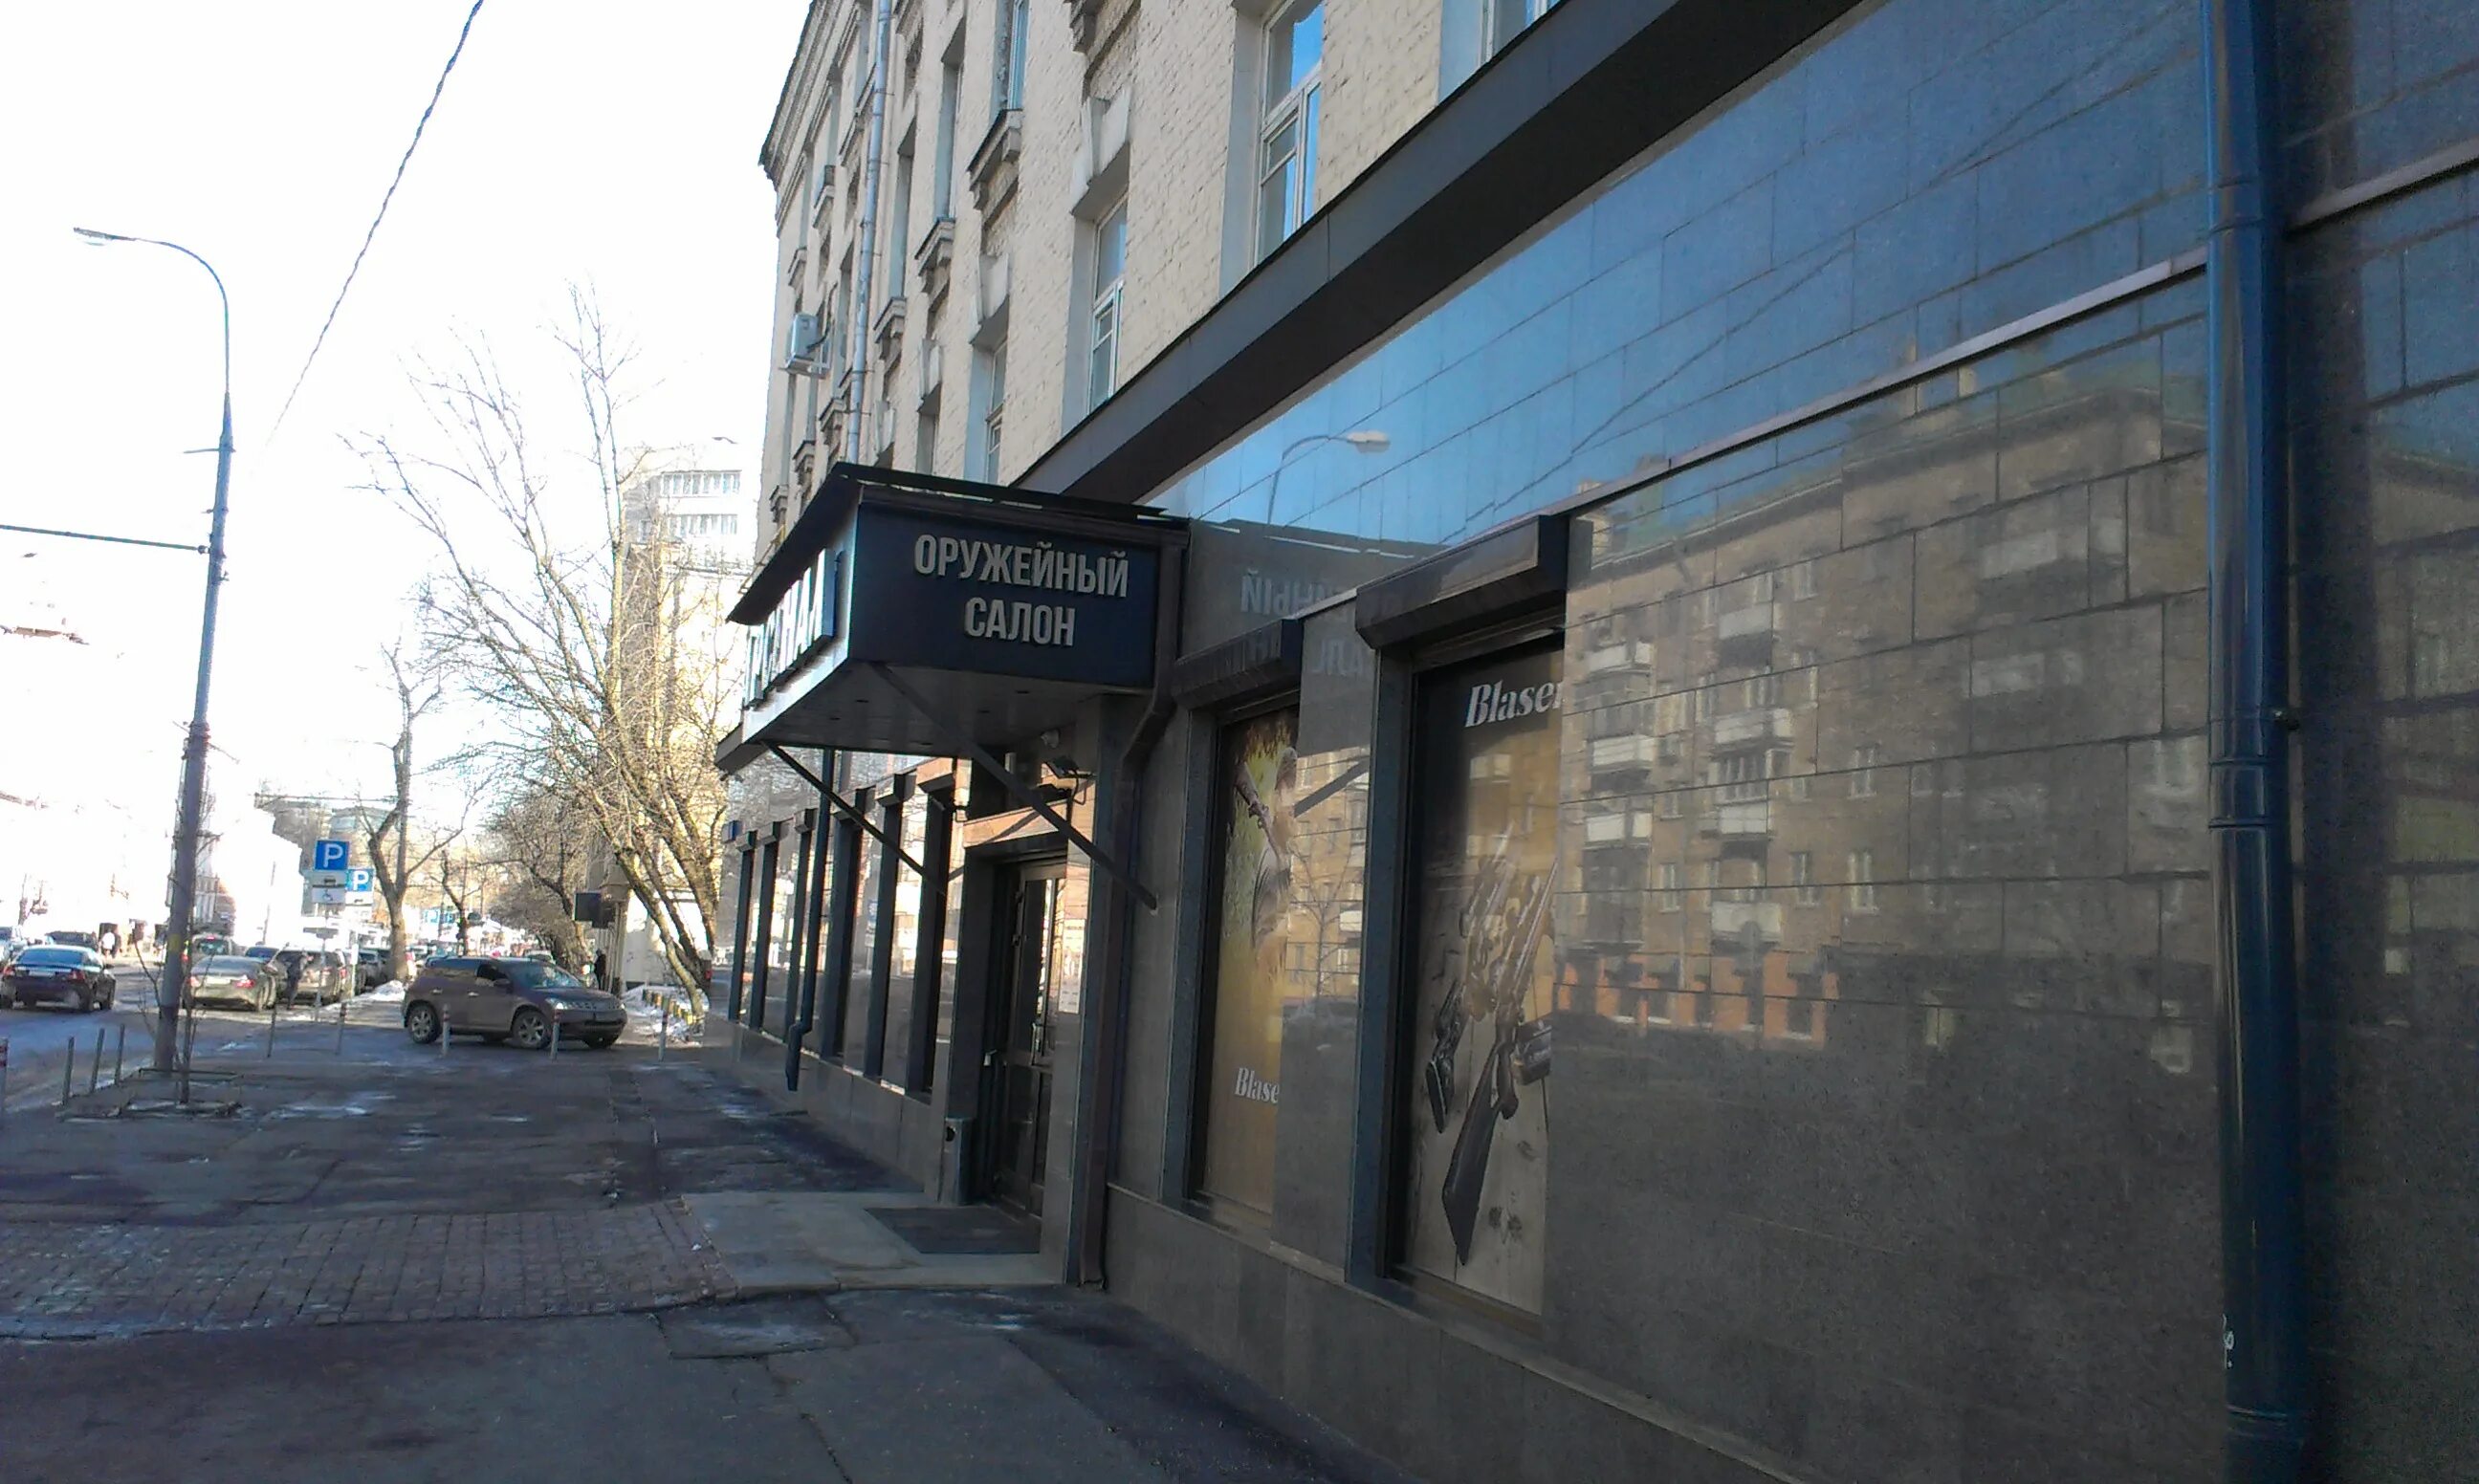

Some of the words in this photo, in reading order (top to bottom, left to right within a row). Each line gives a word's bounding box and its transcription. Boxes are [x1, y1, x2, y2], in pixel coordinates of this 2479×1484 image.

[914, 535, 1129, 598] ОРУЖЕЙНЫЙ
[964, 597, 1076, 646] САЛОН
[1464, 679, 1564, 728] Blaser
[323, 843, 343, 867] P
[353, 871, 369, 891] P
